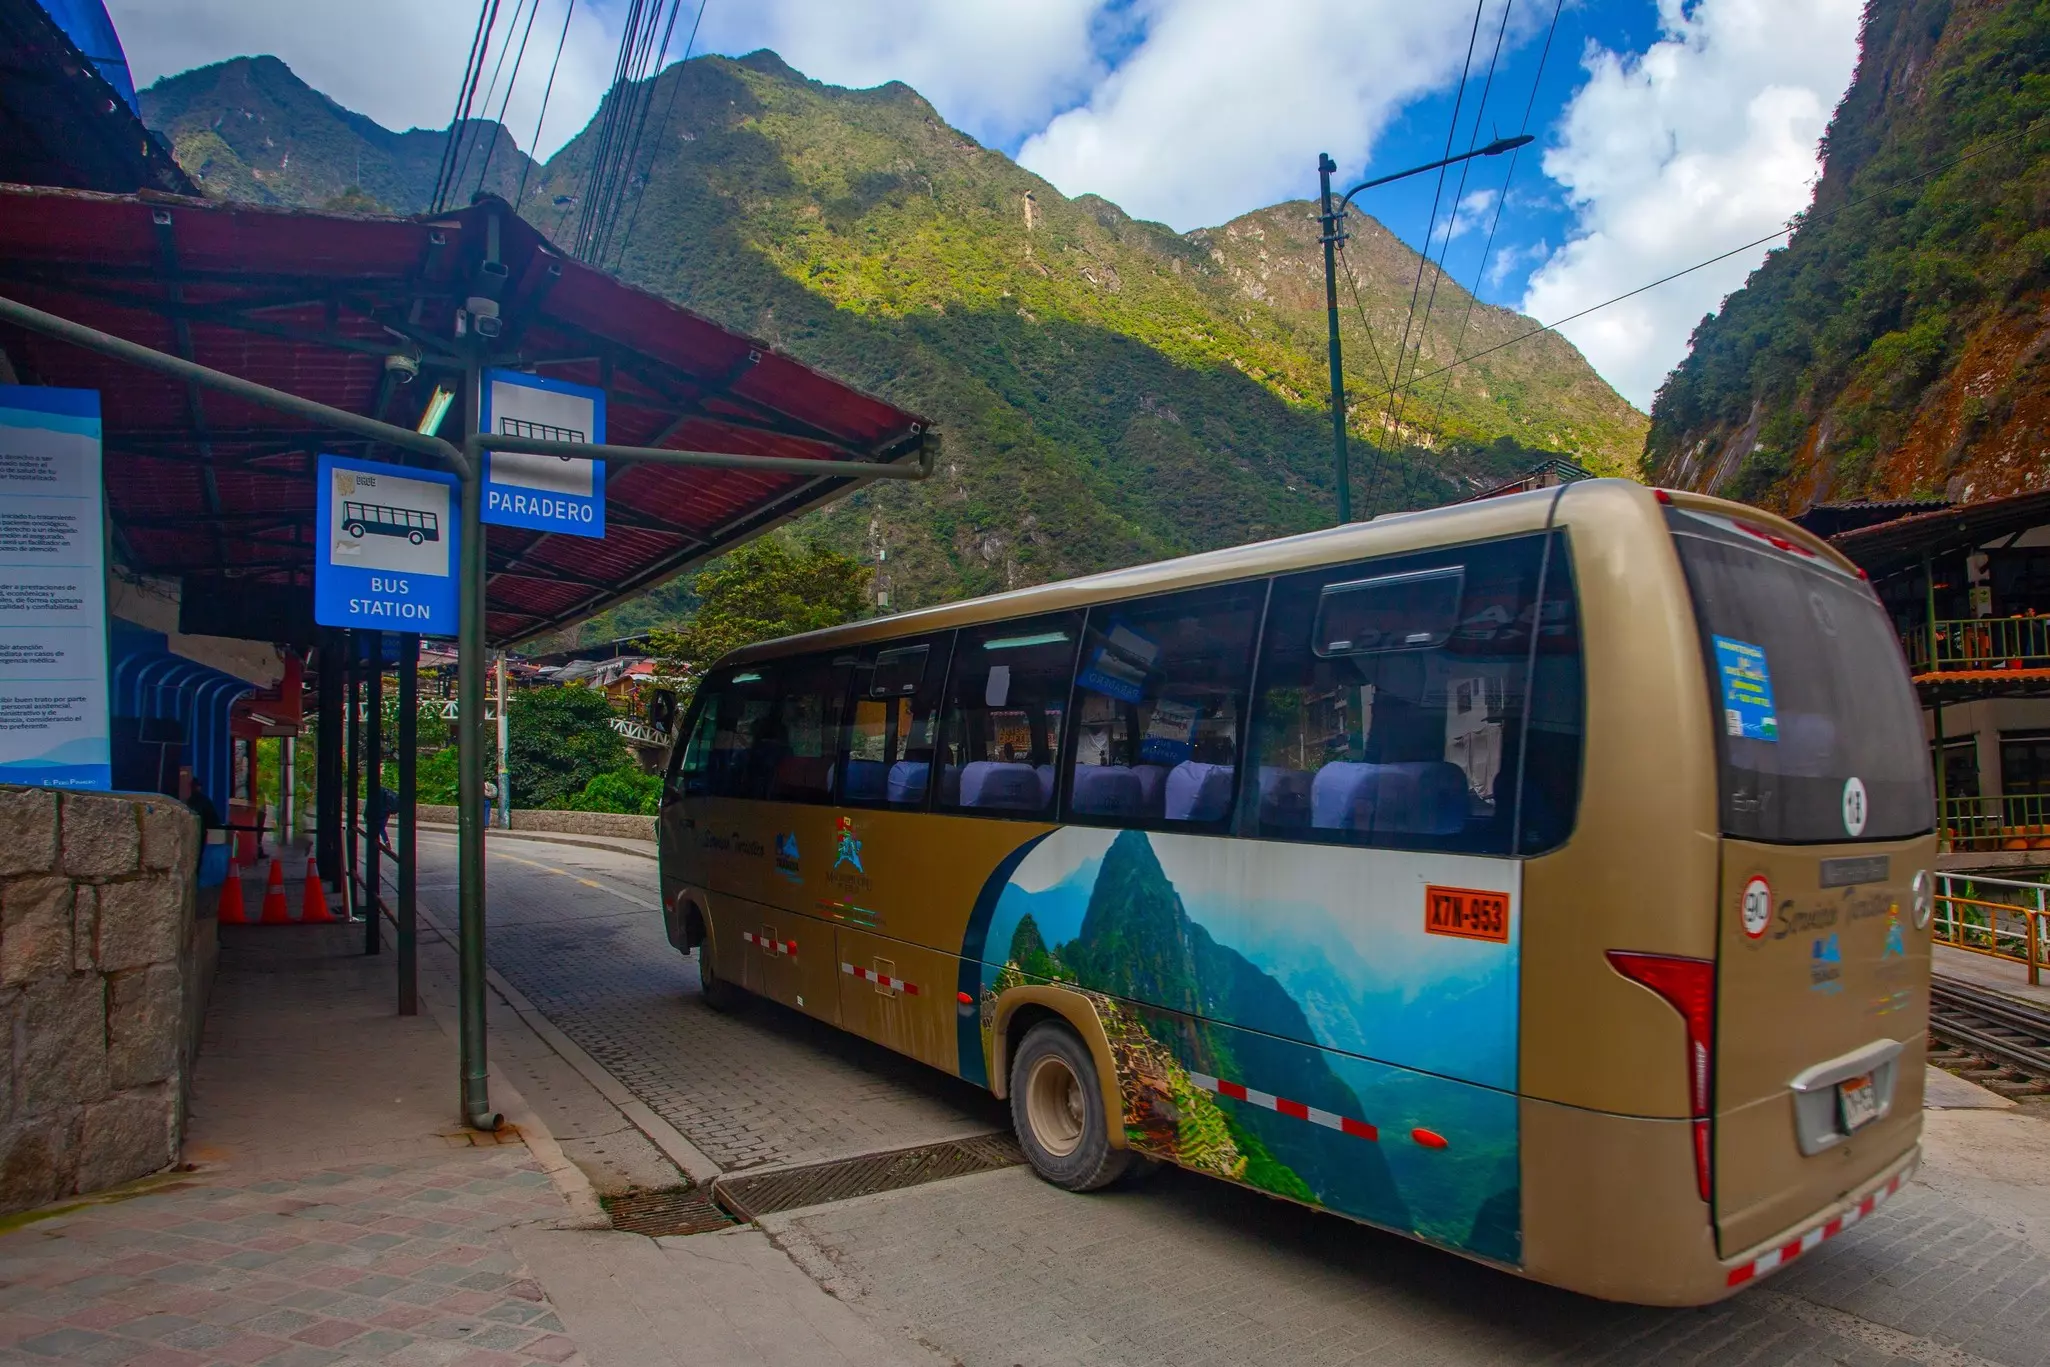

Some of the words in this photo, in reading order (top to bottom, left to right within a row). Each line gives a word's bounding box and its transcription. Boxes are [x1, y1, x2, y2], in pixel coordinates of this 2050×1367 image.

[488, 491, 594, 523] PARADERO
[371, 577, 410, 595] BUS
[349, 598, 431, 620] STATION
[1744, 891, 1769, 923] 90
